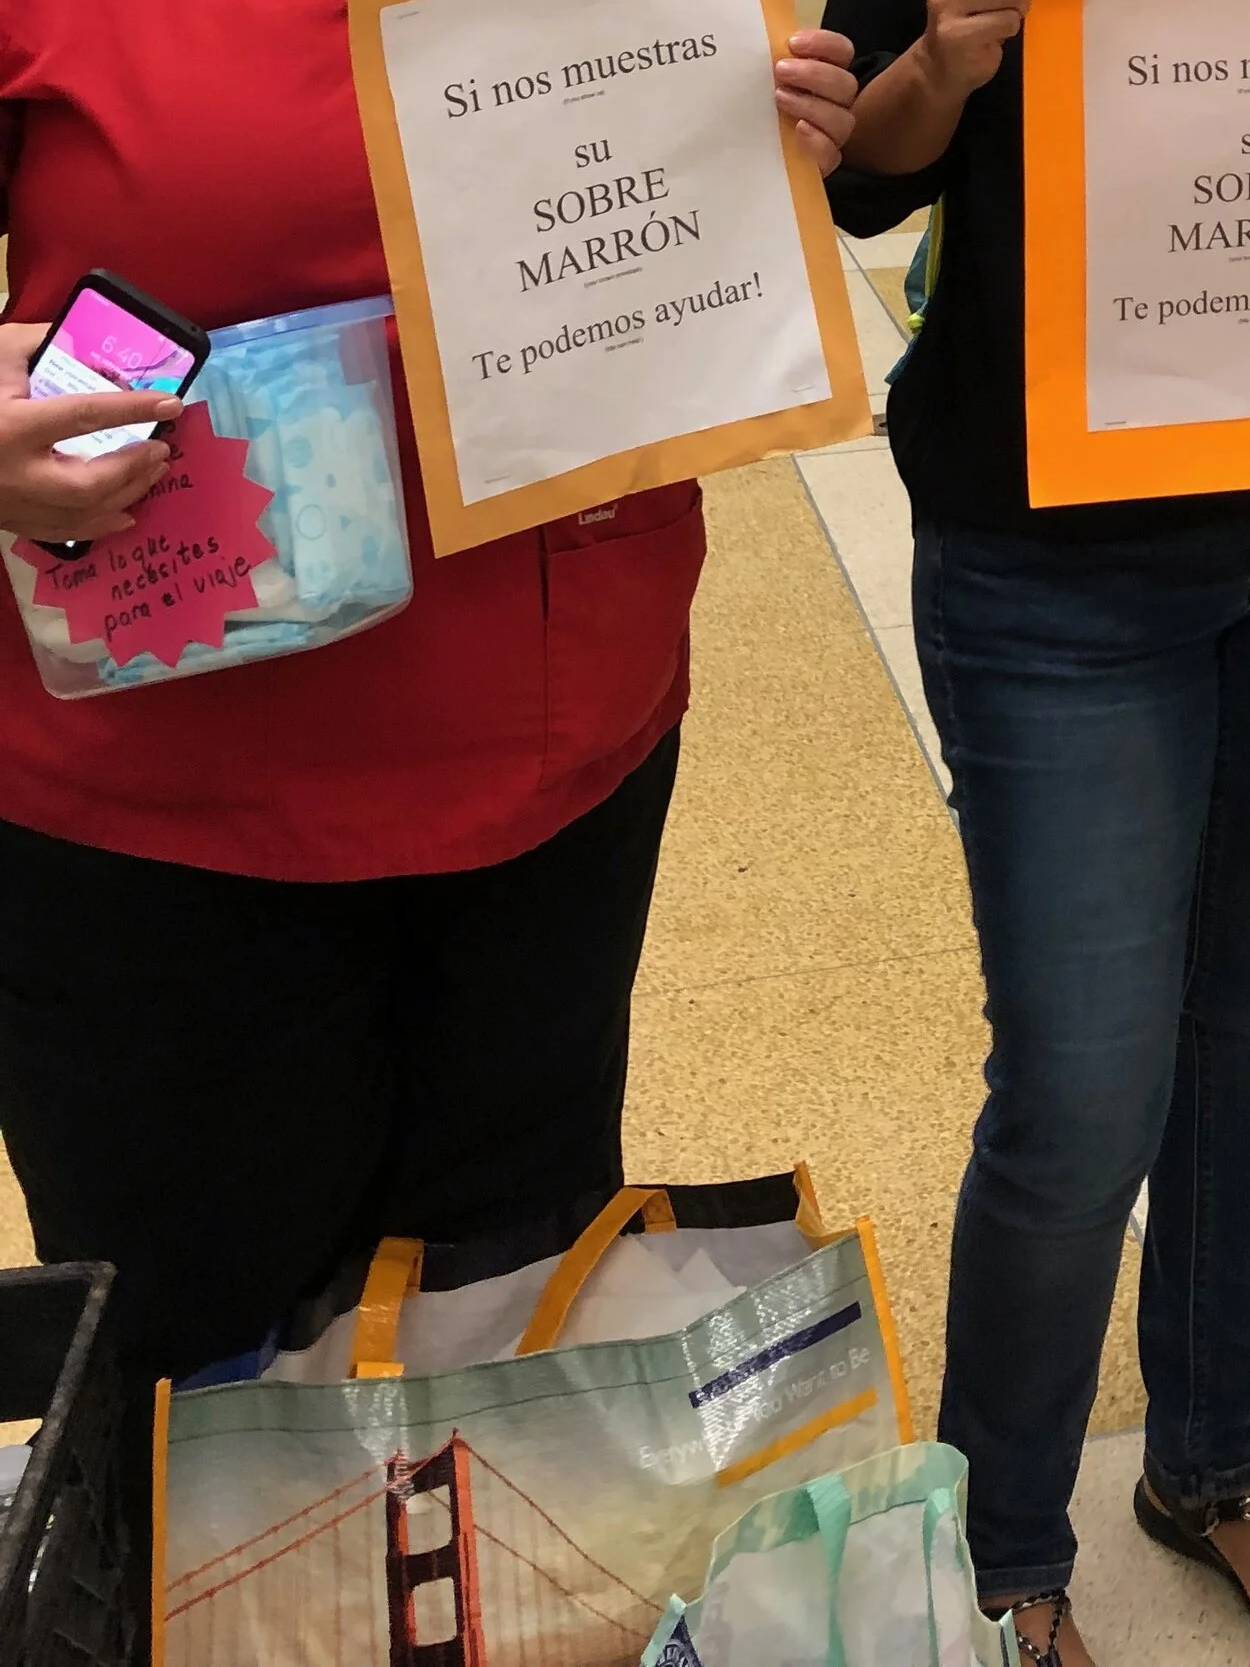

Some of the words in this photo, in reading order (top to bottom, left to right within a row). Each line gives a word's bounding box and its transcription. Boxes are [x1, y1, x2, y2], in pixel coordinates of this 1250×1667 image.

[443, 78, 483, 119] Si
[490, 70, 552, 107] nos
[560, 33, 718, 89] muestras
[1127, 53, 1160, 86] Si
[1171, 59, 1229, 84] nos
[574, 139, 614, 169] su
[533, 167, 670, 233] SOBRE
[515, 209, 702, 293] MARRÓN
[471, 350, 513, 381] Te
[519, 309, 646, 375] podemos
[654, 271, 763, 324] ayudar!
[1113, 296, 1149, 321] Te
[109, 550, 128, 572] lo
[132, 534, 171, 570] que
[103, 602, 152, 641] para
[162, 582, 183, 607] el
[194, 556, 252, 594] viaje
